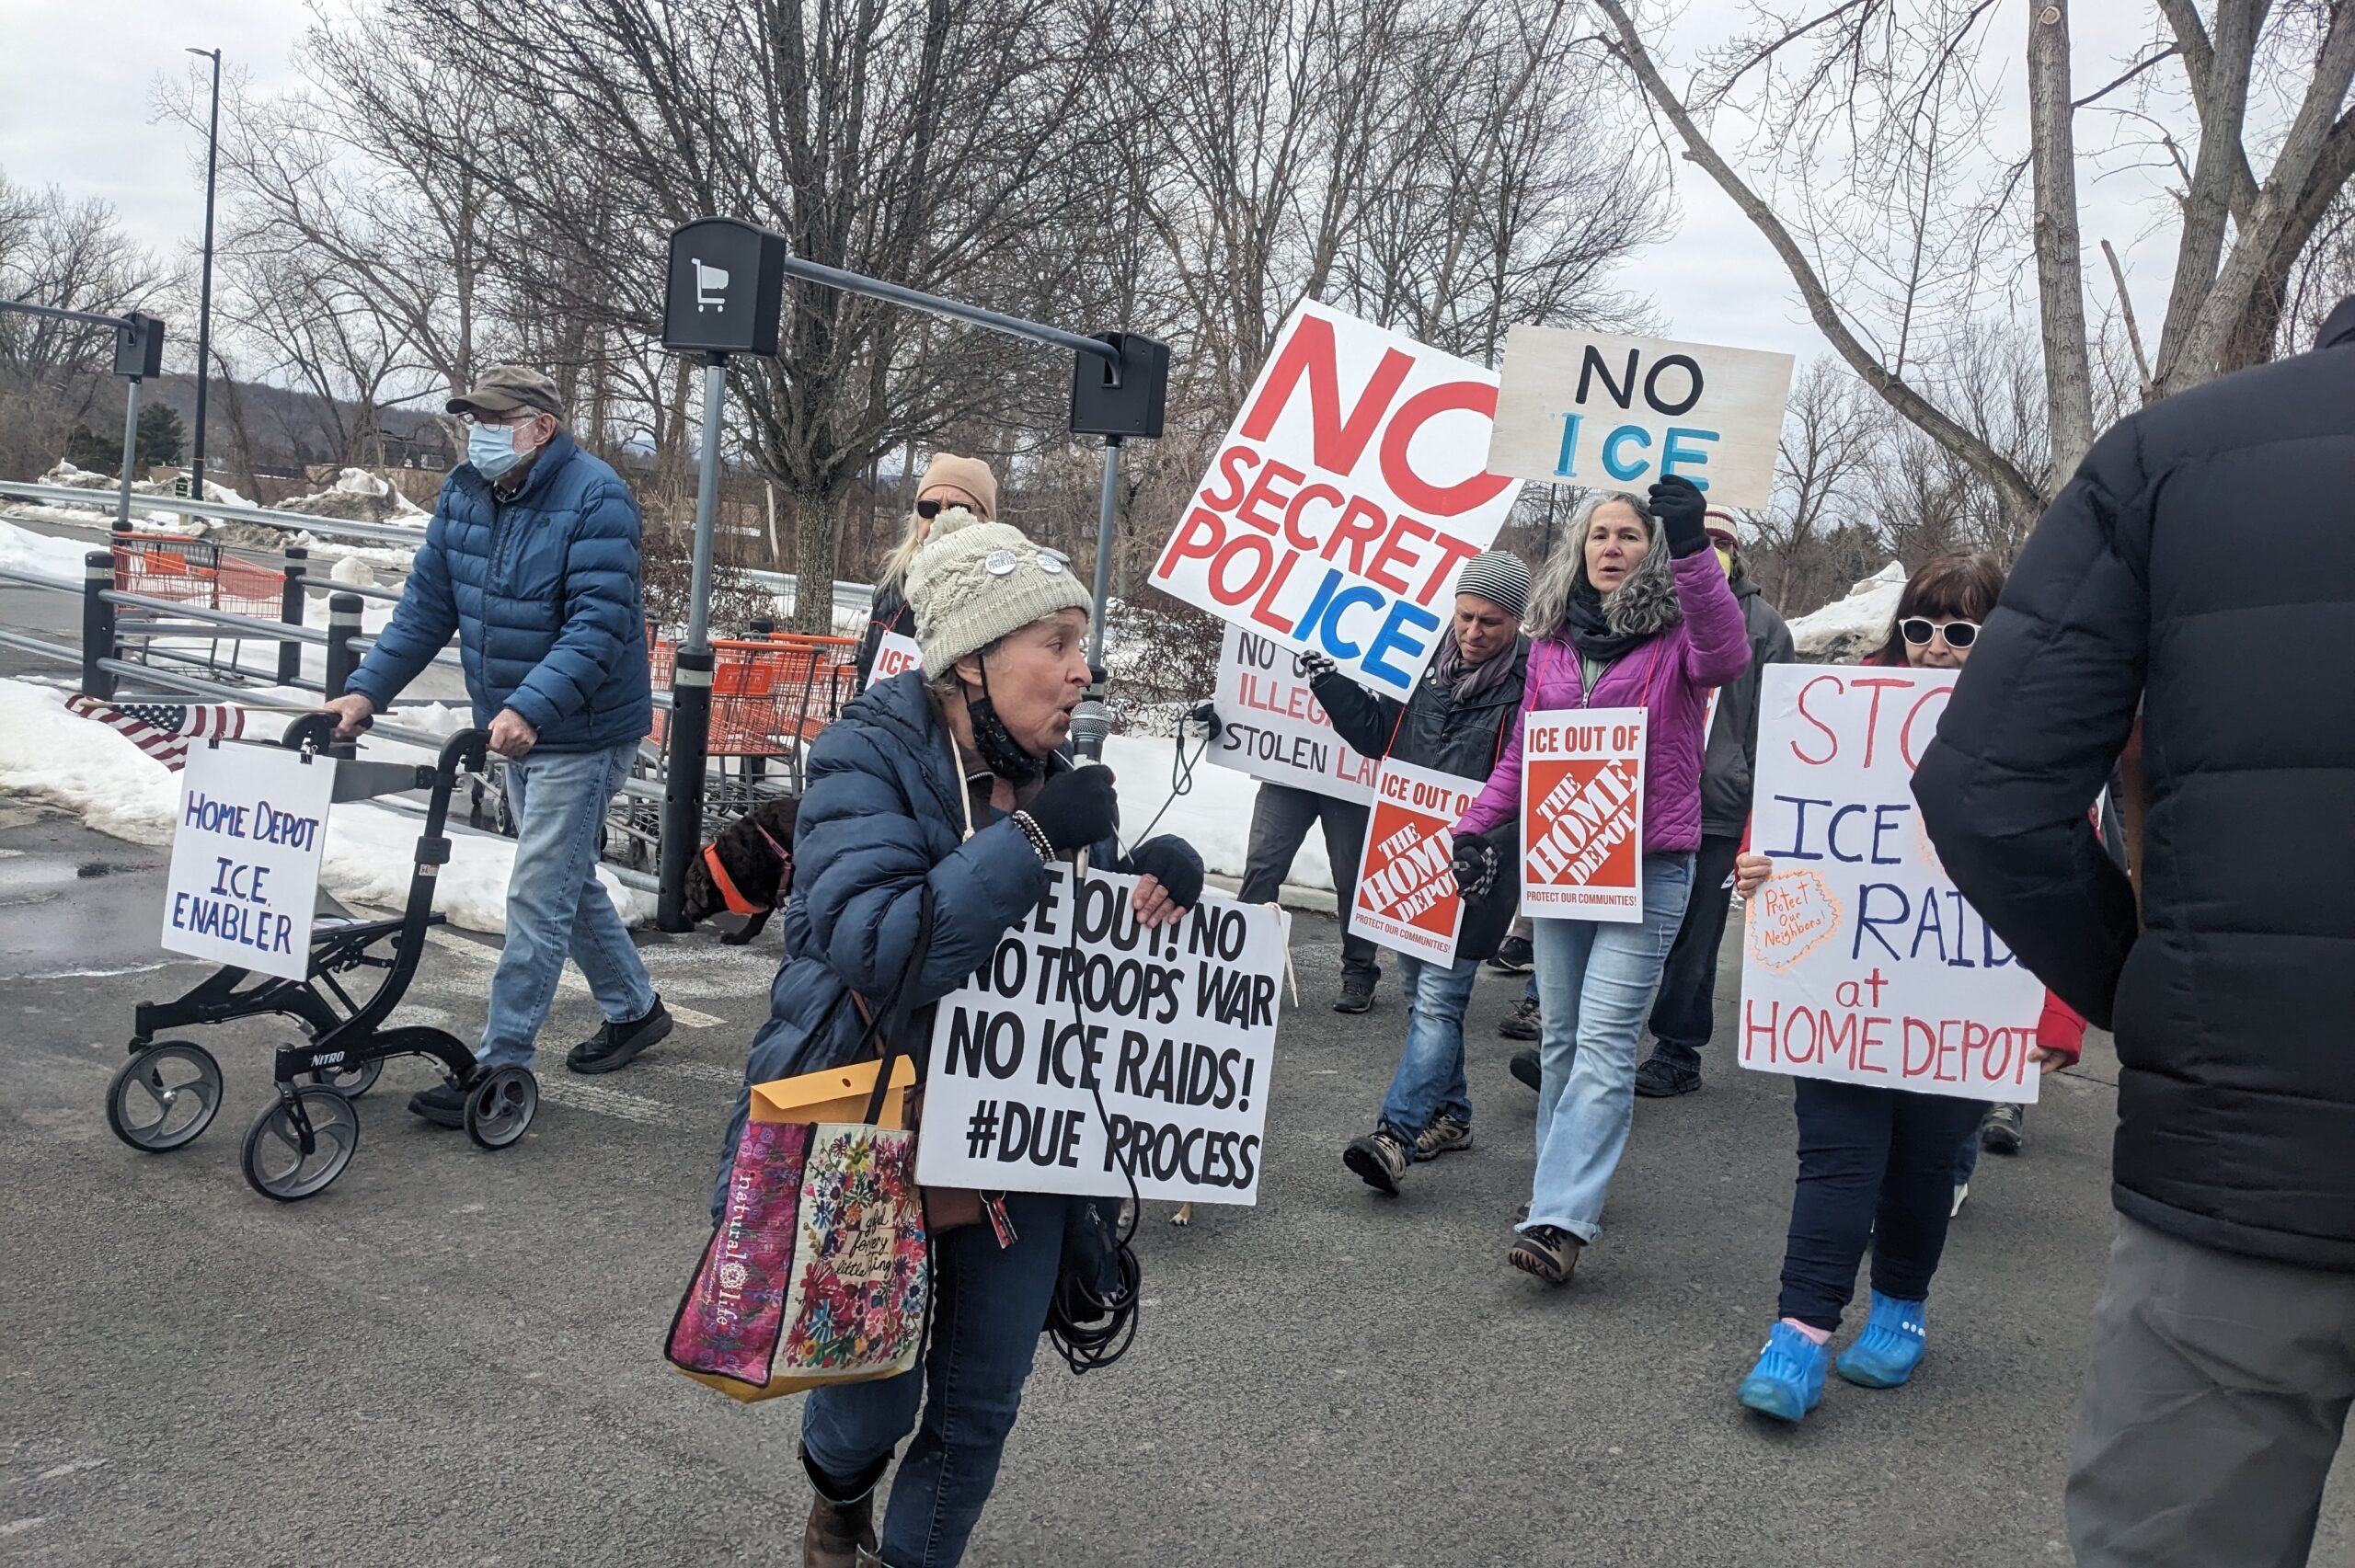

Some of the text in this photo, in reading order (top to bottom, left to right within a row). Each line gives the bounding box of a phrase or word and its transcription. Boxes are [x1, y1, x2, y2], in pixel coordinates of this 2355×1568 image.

[1575, 345, 1704, 416] NO
[1240, 314, 1513, 517] NO
[1554, 412, 1720, 491] ICE
[1200, 445, 1482, 606] SECRET
[1157, 507, 1440, 689] POLICE
[1237, 632, 1276, 670] NO
[1238, 672, 1333, 727] ILLEG
[1790, 675, 1957, 772] STO
[1223, 723, 1381, 788] STOLEN LA
[1529, 725, 1640, 753] ICE OUT OF
[185, 790, 319, 852] HOME DEPOT
[1380, 772, 1410, 801] ICE
[1412, 783, 1452, 812] OUT
[1526, 759, 1638, 885] HOME
[1535, 773, 1582, 823] THE
[1377, 821, 1421, 861] THE
[1567, 806, 1637, 886] DEPOT
[1763, 795, 1911, 864] ICE
[172, 892, 292, 954] ENABLER
[1526, 890, 1637, 906] PROTECT OUR COMMUNITIES!
[1765, 879, 1808, 917] Protect
[1779, 911, 1800, 926] Our
[1852, 883, 2031, 969] RAID
[1188, 901, 1246, 962] NO
[1355, 912, 1451, 954] PROTECT OUR COMMUNITIES!
[1036, 944, 1185, 1024] TROOPS
[1197, 960, 1275, 1030] WAR
[1836, 967, 1889, 1008] at
[311, 1050, 345, 1067] NITRO
[944, 1006, 1255, 1113] NO ICE RAIDS!
[1745, 999, 2038, 1084] HOME DEPOT
[966, 1100, 1260, 1190] #DUE PROCESS
[717, 1175, 752, 1326] natural life
[836, 1259, 867, 1276] little
